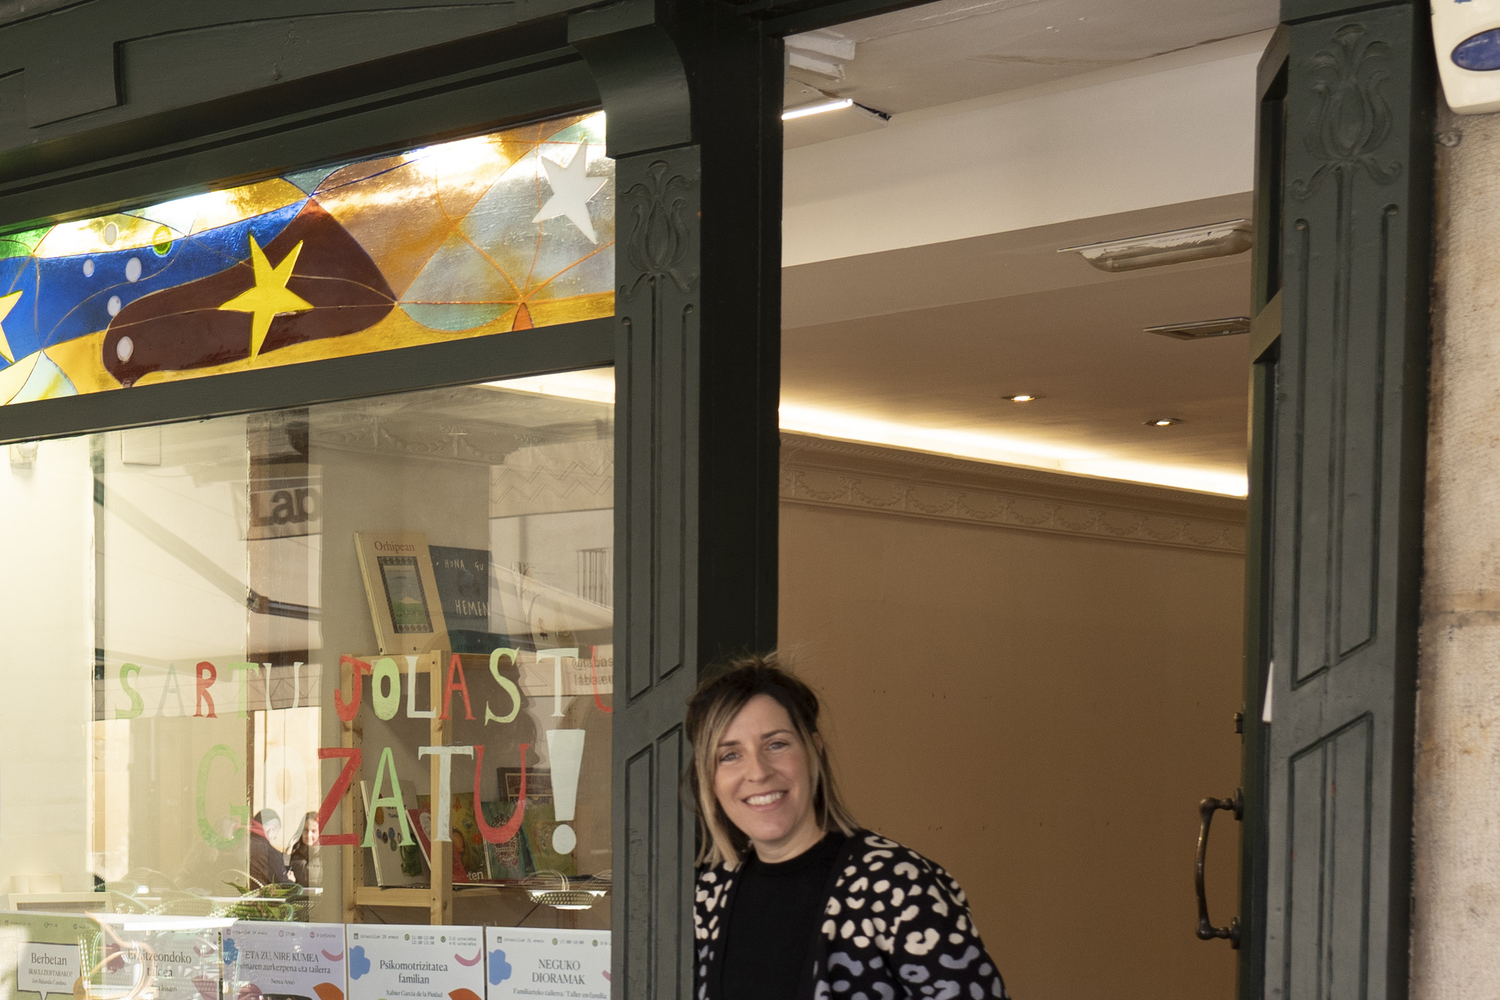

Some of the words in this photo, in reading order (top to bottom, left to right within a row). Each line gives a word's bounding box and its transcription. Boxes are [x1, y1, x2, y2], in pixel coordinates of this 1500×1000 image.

[374, 540, 416, 554] Orhipean
[454, 599, 491, 617] HEMEN
[115, 660, 304, 720] SARTU
[196, 728, 587, 855] GOZATU!
[31, 952, 68, 966] Berbetan
[127, 949, 192, 964] Eitzeondoko
[292, 953, 319, 963] KUMEA
[379, 959, 449, 972] Psikomotrizitatea
[538, 958, 581, 971] NEGUKO
[398, 972, 430, 985] familian
[532, 972, 586, 985] DIORAMAK
